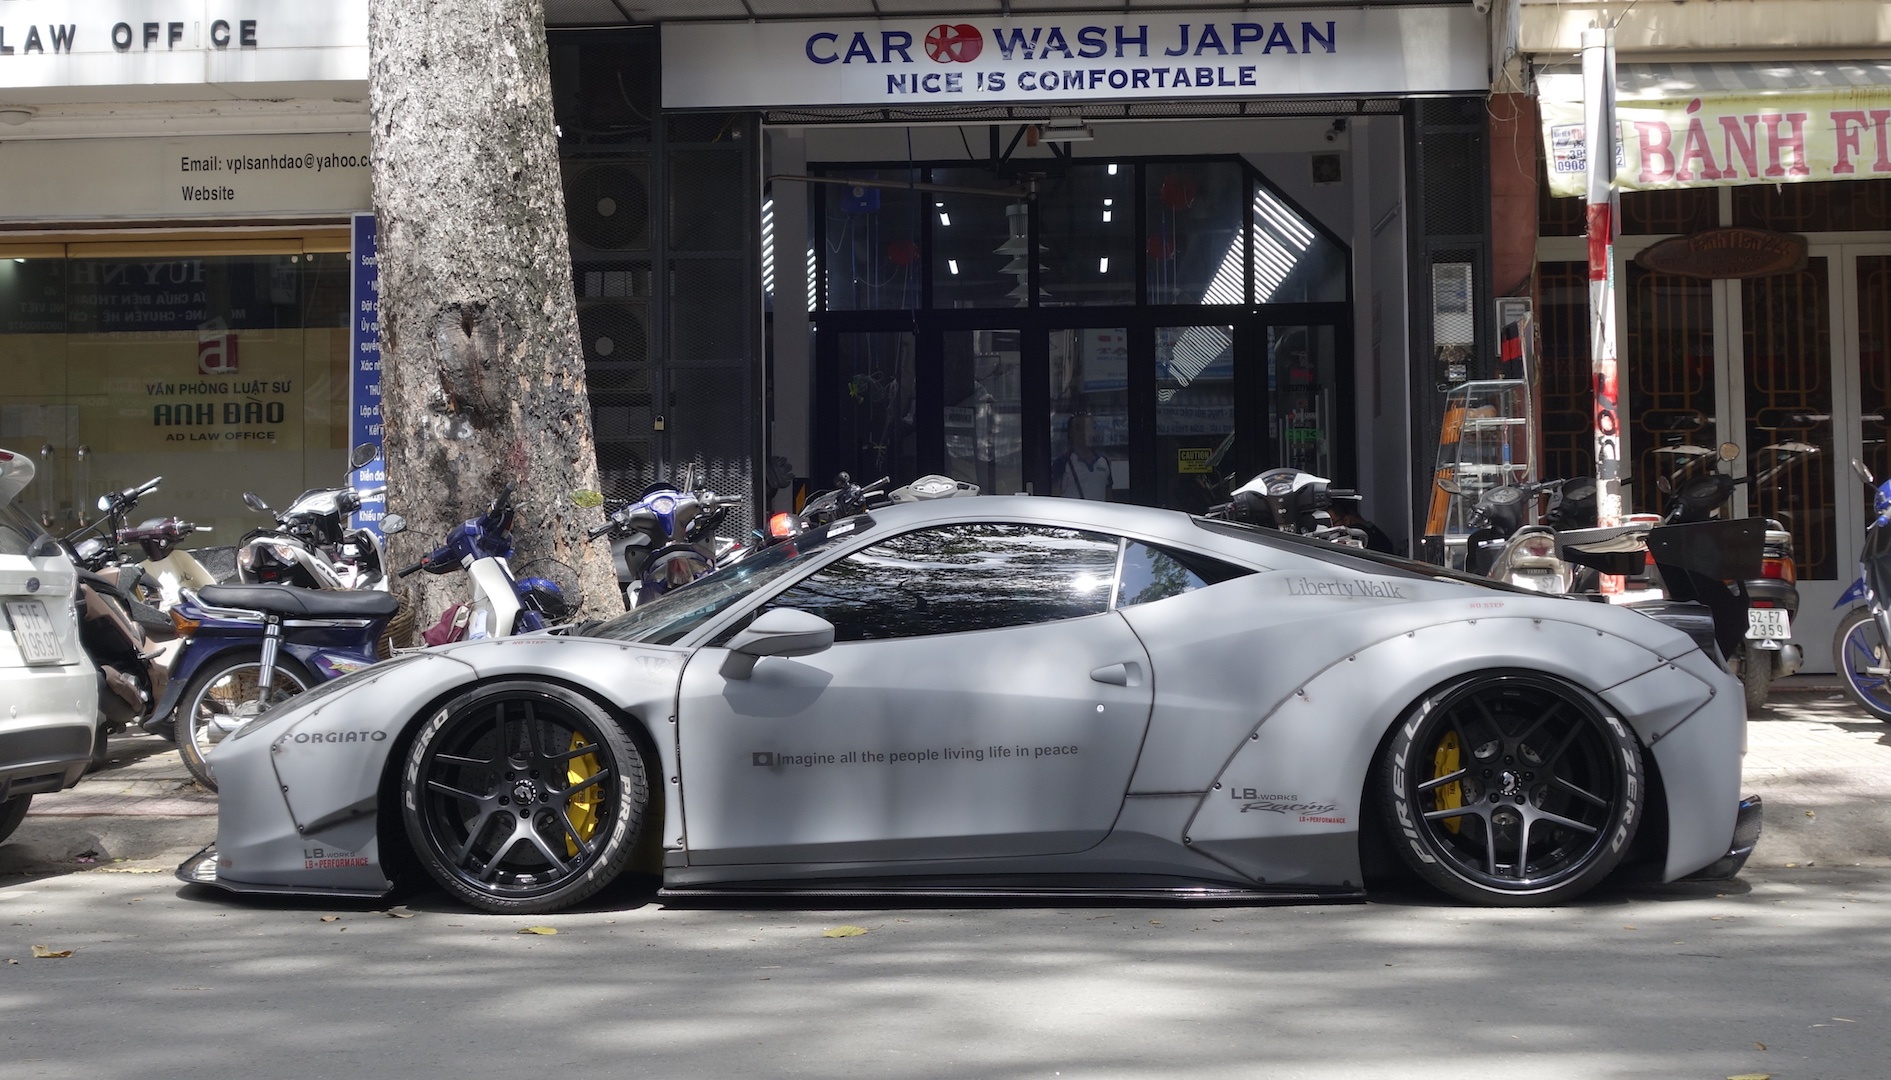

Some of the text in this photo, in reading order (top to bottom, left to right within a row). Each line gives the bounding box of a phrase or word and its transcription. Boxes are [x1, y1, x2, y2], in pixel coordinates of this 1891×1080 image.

[0, 20, 257, 53] LAW OFFCE
[805, 21, 1337, 64] CAR WASH JAPAN
[887, 65, 1257, 95] NICE IS COMFORTABLE
[1634, 97, 1810, 183] BÁNH
[181, 152, 373, 175] Email: vplsanhdao@yahoo.c
[1558, 160, 1586, 171] 0908
[182, 186, 234, 201] Website
[146, 382, 175, 395] VĂN
[180, 380, 228, 395] PHÒNG
[233, 380, 268, 395] LUẬT
[272, 380, 292, 394] SƯ
[153, 396, 285, 426] ANH ĐÀO
[166, 431, 276, 442] AD LAW OFFICE
[1181, 451, 1210, 460] CAUTION
[1285, 577, 1406, 599] Liberty Walk
[1750, 611, 1780, 623] 52-F7
[1751, 624, 1783, 636] 2359
[281, 730, 387, 744] FORGIATO
[406, 708, 449, 811] P ZERO
[777, 744, 1079, 767] Imagine all the people living life in peace
[1393, 700, 1437, 864] PIRELLI
[1605, 716, 1639, 853] P ZERO
[1240, 801, 1338, 815] Racing
[587, 774, 633, 882] PIRELLI
